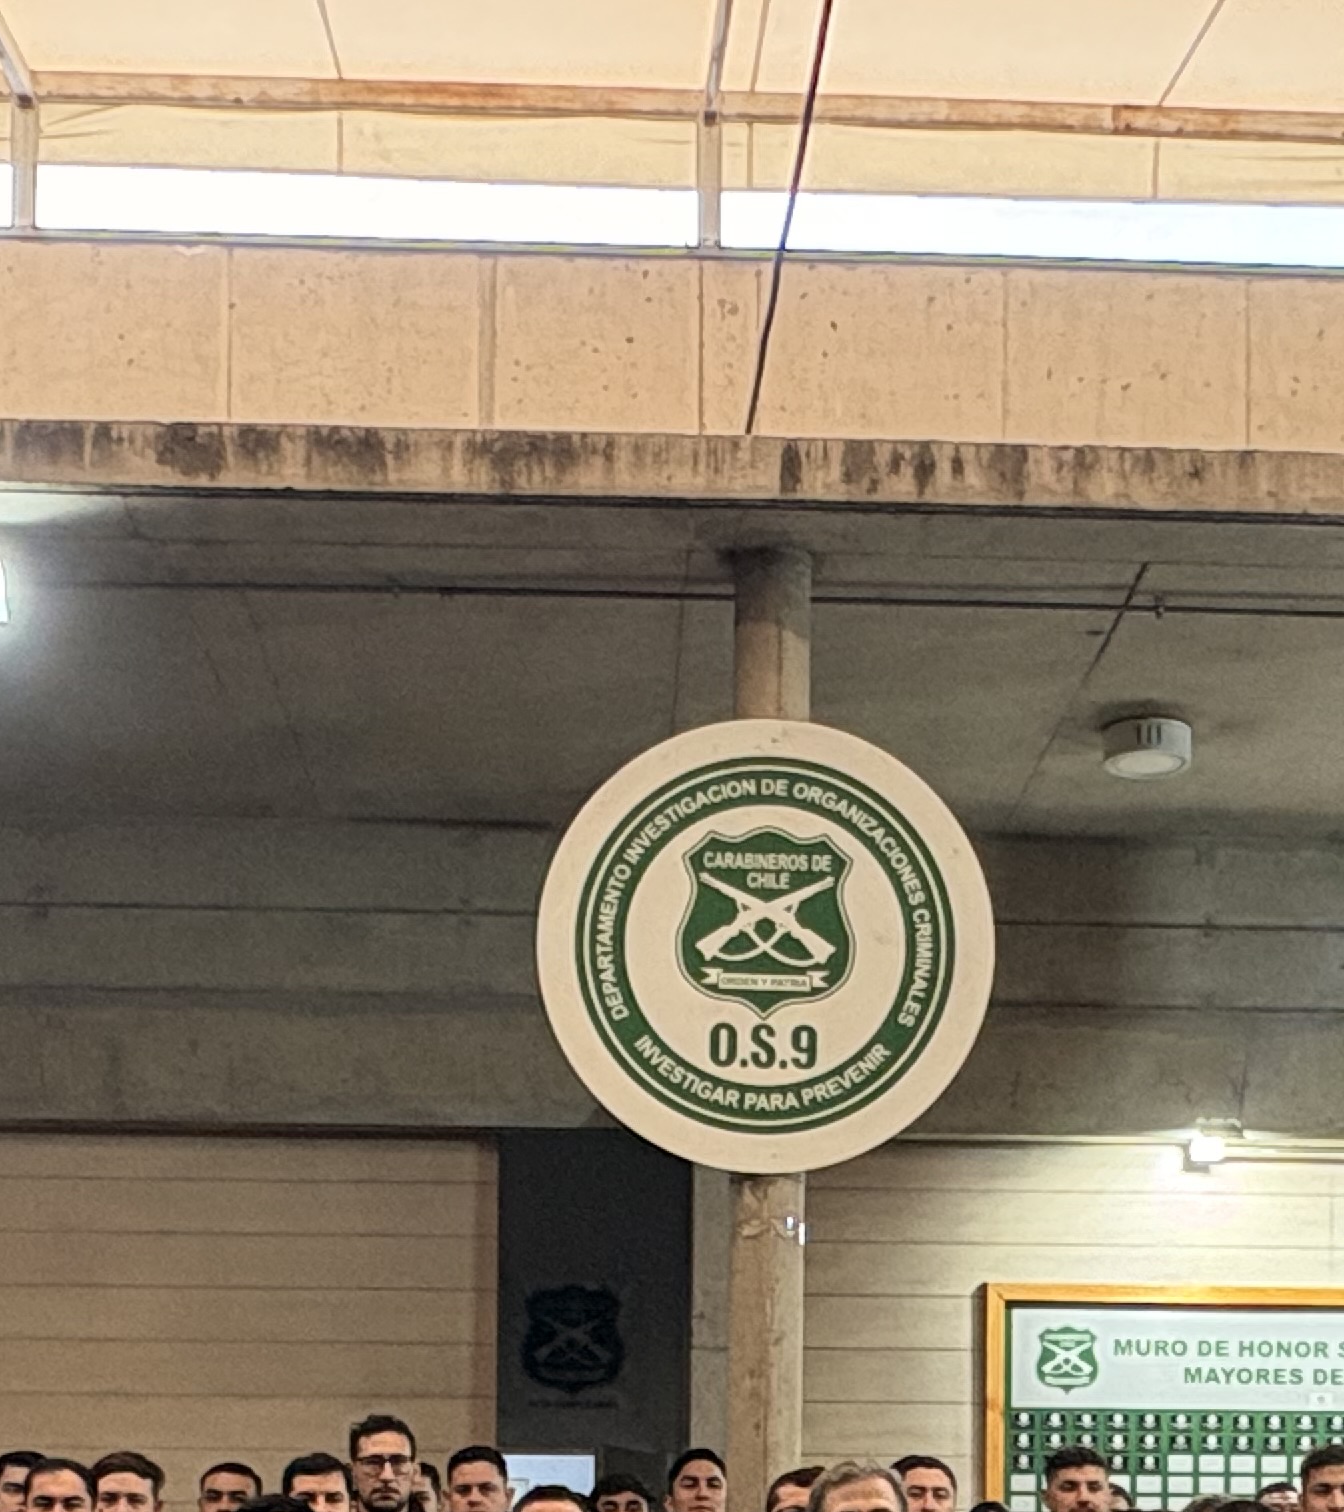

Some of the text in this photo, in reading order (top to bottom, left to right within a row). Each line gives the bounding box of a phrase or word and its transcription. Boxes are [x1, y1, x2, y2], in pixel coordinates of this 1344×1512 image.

[703, 851, 832, 872] CARABINEROS DE
[746, 872, 791, 889] CHILE
[594, 778, 935, 1029] DEPARTAMENTO INVESTIGACION DE ORGANIZACIONES CRIMINALES
[709, 1022, 819, 1071] O.S.9
[633, 1033, 892, 1112] INVESTIGAR PARA PREVENIR
[1113, 1337, 1189, 1358] MURO
[1197, 1338, 1231, 1358] DE
[1237, 1339, 1329, 1360] HONOR
[1183, 1365, 1305, 1386] MAYORES
